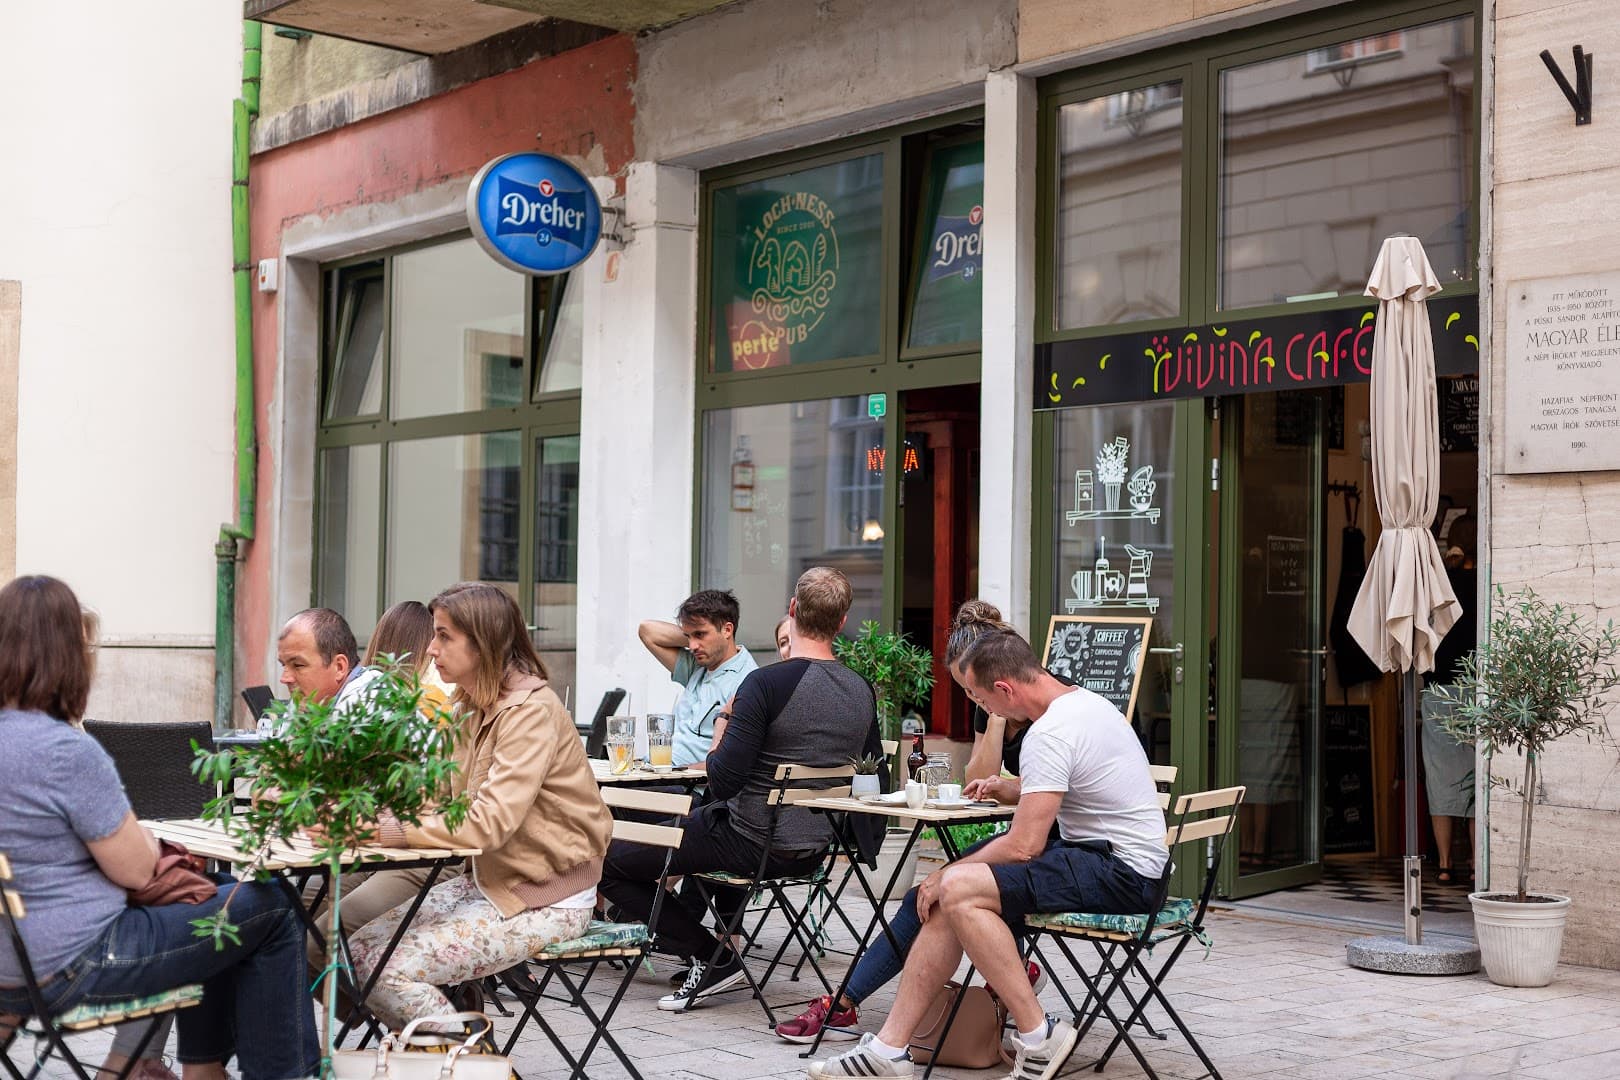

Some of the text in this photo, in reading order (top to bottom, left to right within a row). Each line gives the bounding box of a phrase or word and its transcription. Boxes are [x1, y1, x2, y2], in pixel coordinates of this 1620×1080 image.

[502, 192, 585, 231] Dreher
[539, 233, 550, 243] 24
[1552, 293, 1564, 301] ITT
[775, 323, 808, 345] PUB
[1526, 328, 1589, 349] MAGYAR
[1530, 423, 1558, 432] MAGYAR
[1097, 630, 1124, 643] COFFEE
